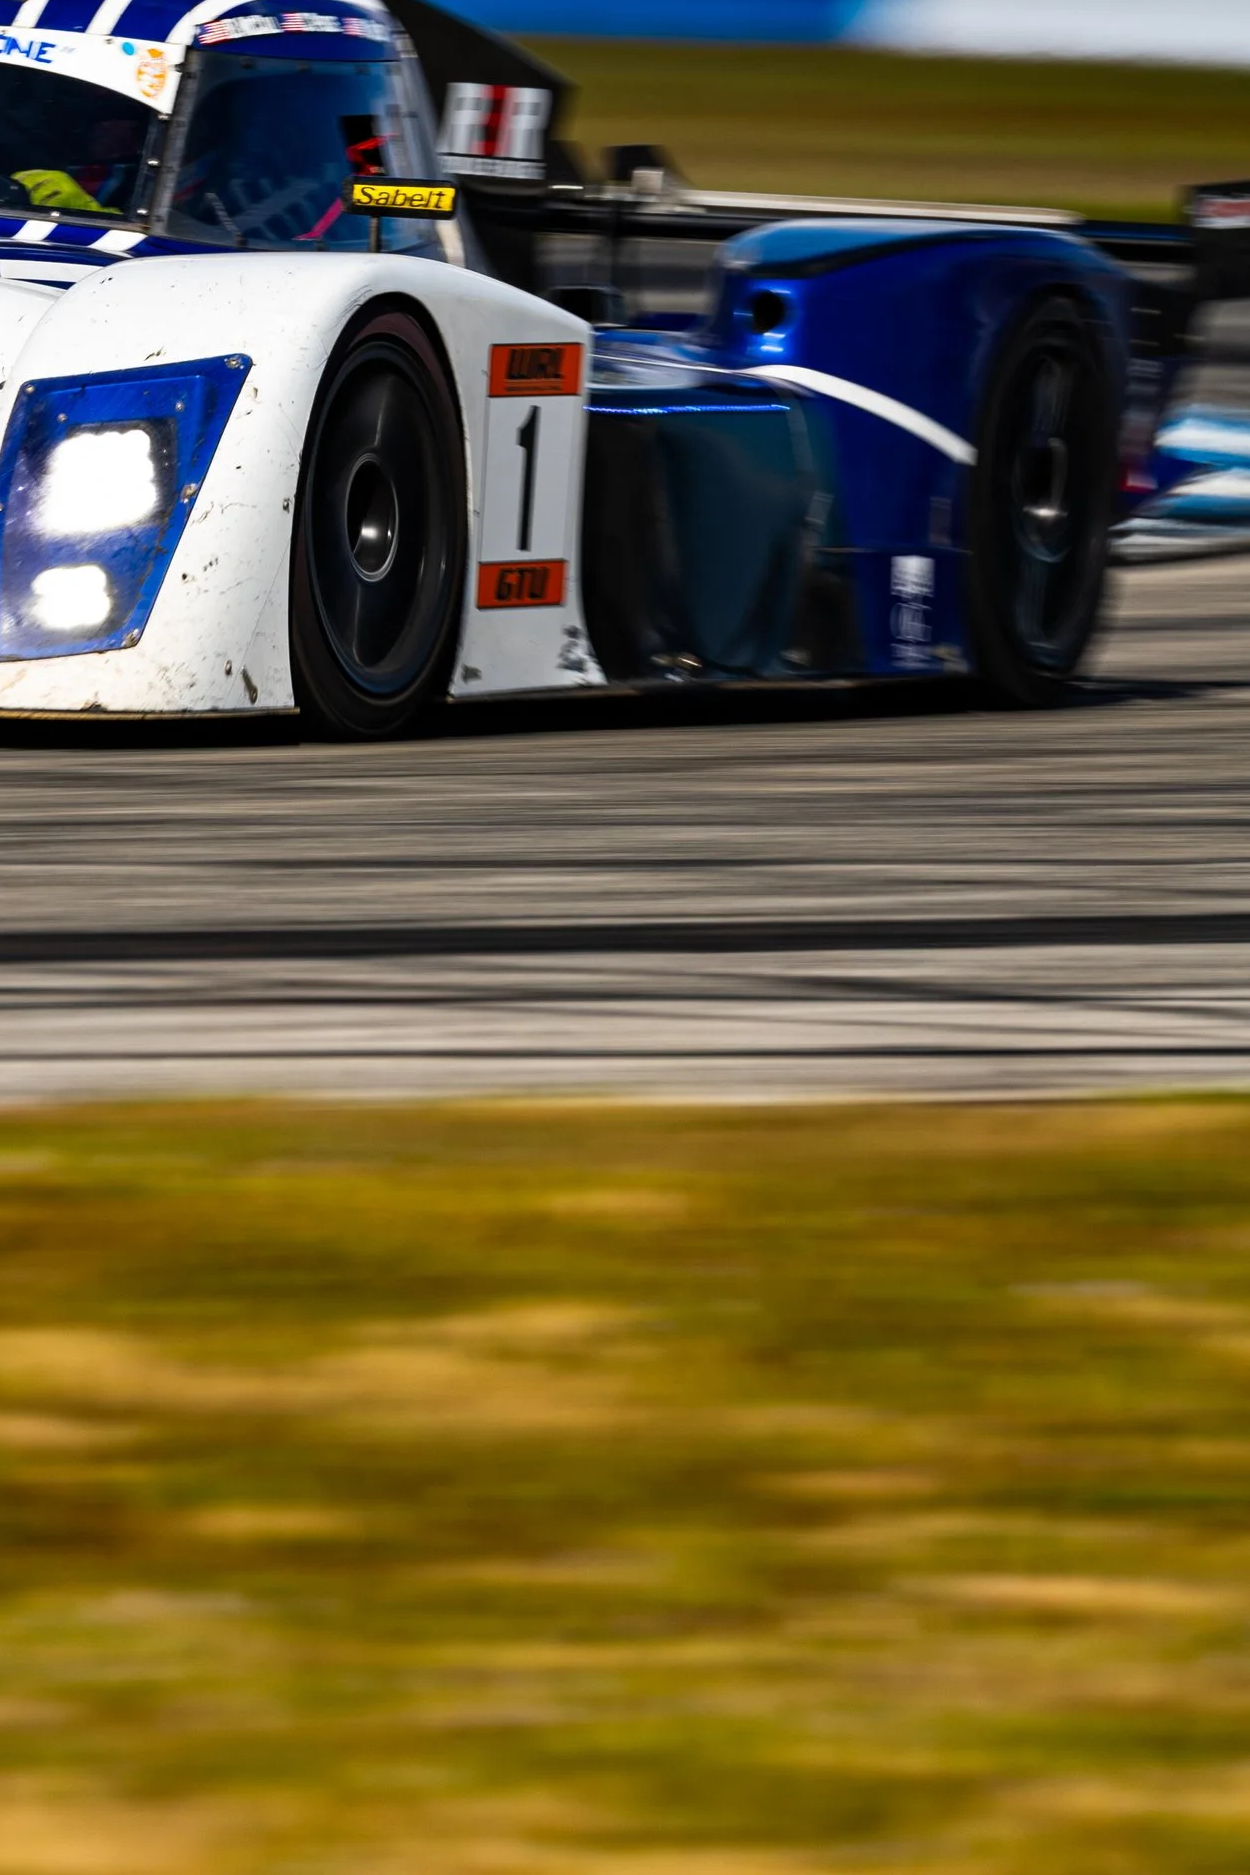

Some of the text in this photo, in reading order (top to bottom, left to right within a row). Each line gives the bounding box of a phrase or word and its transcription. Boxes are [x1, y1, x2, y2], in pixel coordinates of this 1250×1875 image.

[354, 186, 447, 209] Sabelt
[515, 404, 542, 552] 1
[494, 566, 550, 601] GTU
